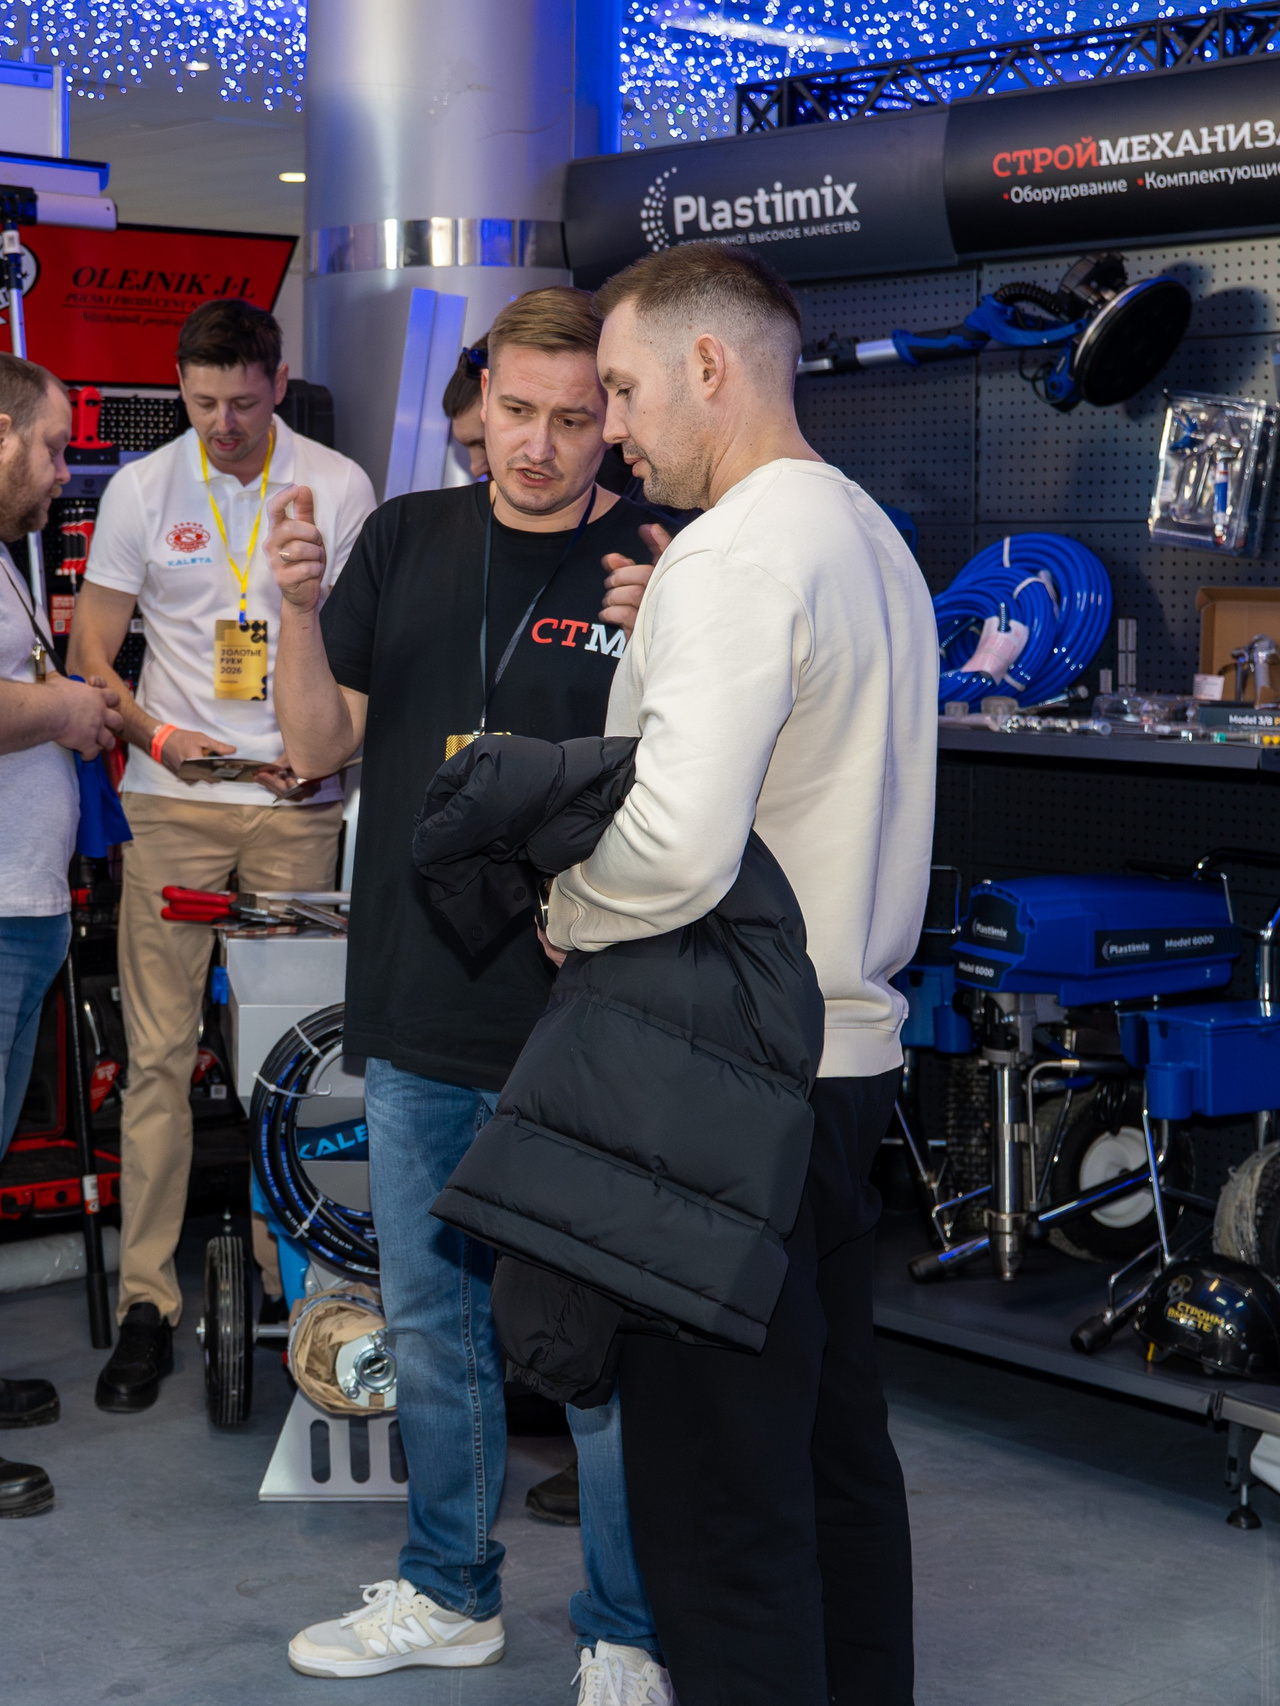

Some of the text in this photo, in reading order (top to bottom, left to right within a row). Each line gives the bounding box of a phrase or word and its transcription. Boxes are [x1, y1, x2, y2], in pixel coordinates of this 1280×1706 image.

[673, 174, 859, 235] Plastimix
[1010, 177, 1128, 204] Оборудование
[748, 227, 801, 244] ВЫСОКОЕ
[803, 220, 861, 238] КАЧЕСТВО
[72, 265, 211, 295] OLEJNIK
[531, 618, 627, 659] СТМ
